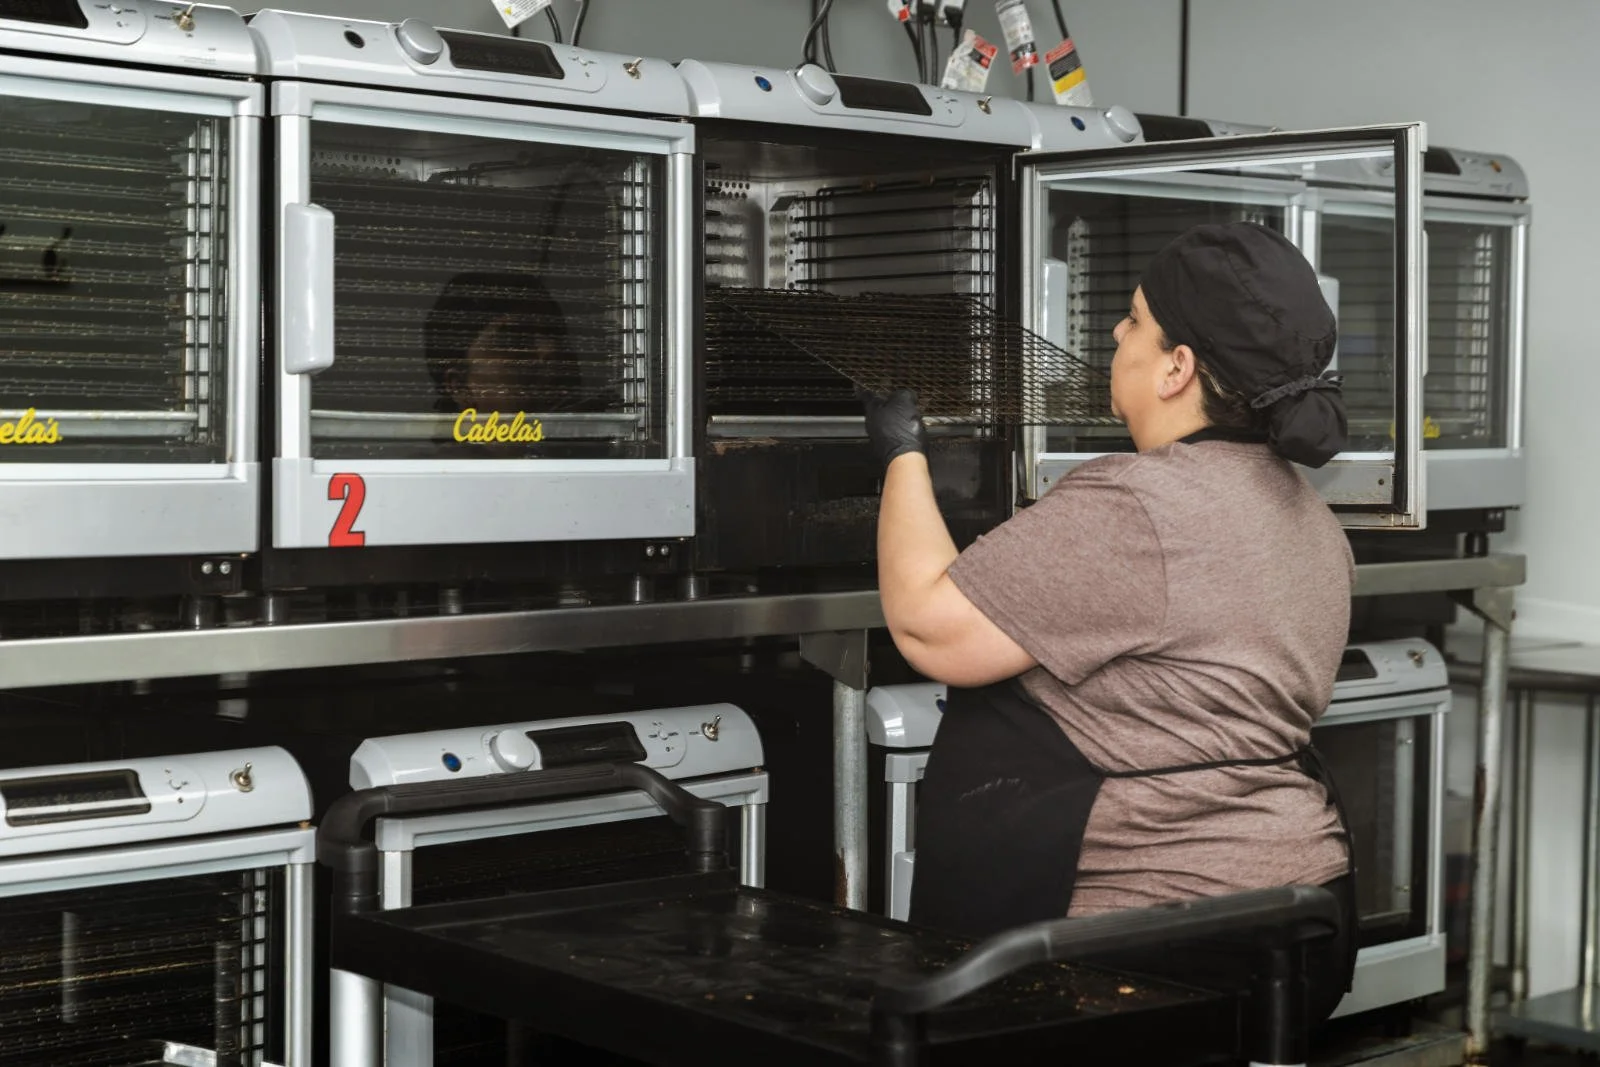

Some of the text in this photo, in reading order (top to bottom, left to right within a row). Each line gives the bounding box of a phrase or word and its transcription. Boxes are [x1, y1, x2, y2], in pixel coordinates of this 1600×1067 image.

[0, 407, 60, 444] ela's
[453, 408, 543, 442] Cabela's
[328, 472, 366, 548] 2
